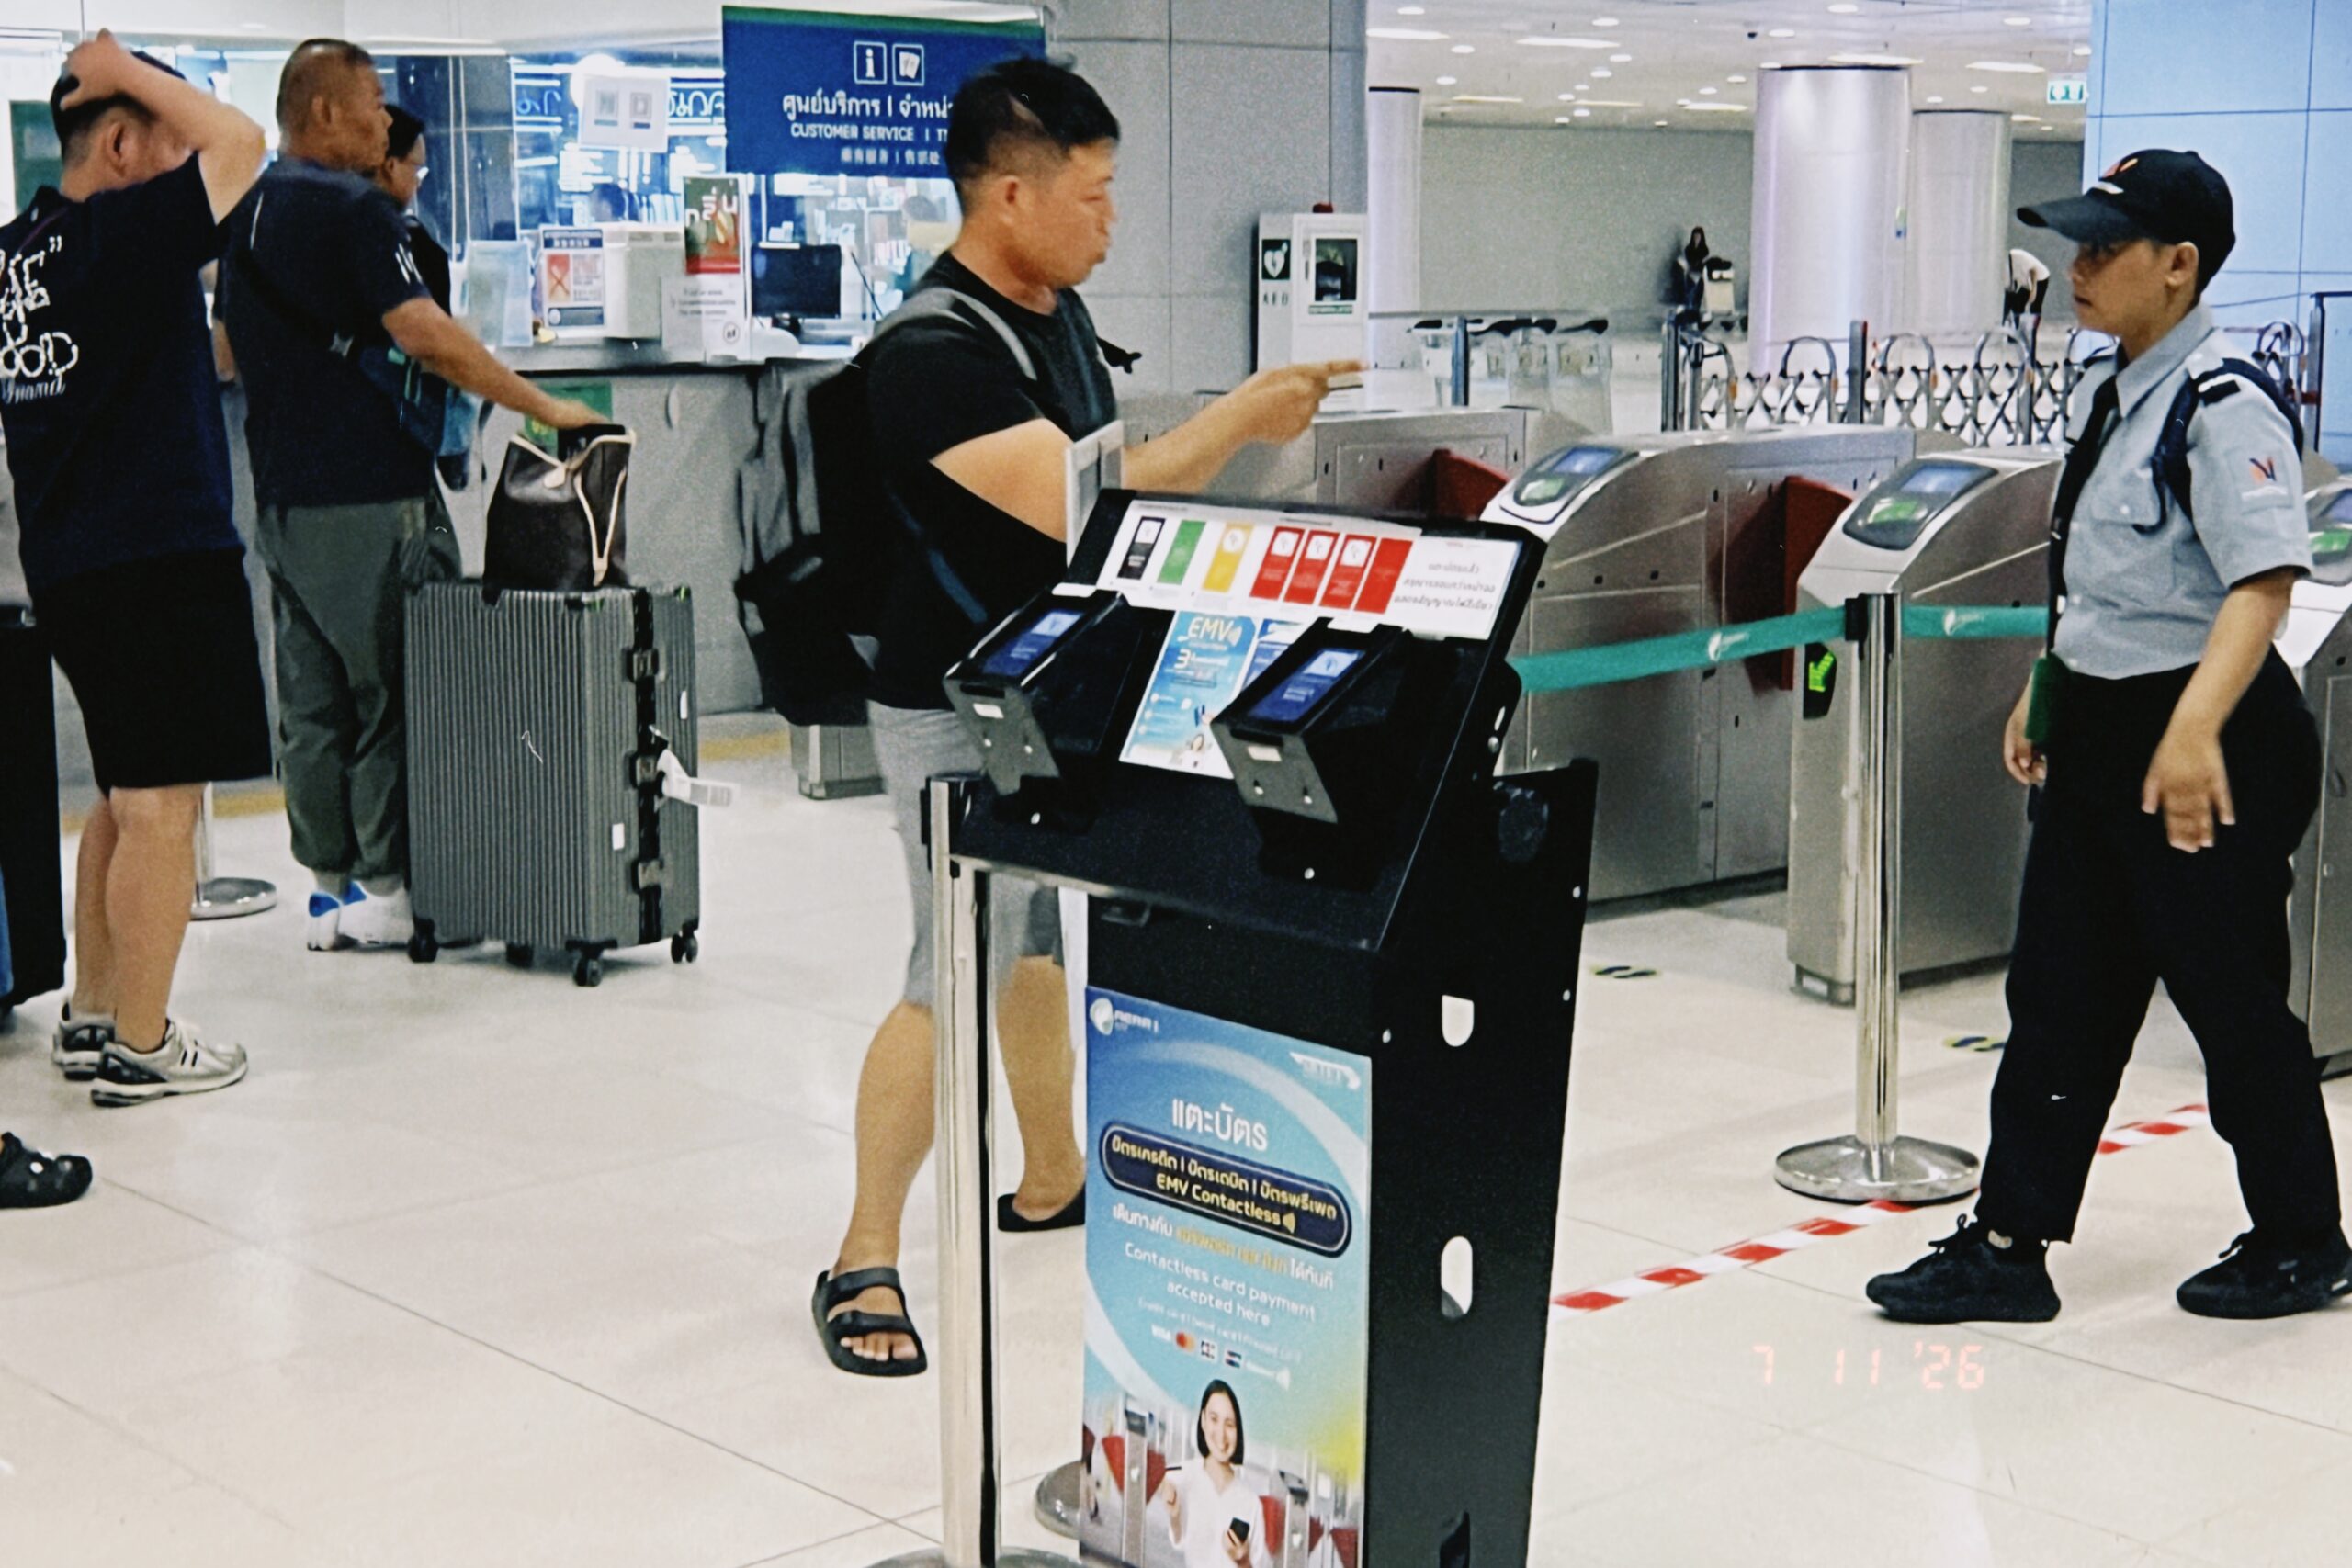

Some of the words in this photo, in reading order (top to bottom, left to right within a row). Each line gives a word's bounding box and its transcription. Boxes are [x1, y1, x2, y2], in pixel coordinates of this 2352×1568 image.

[783, 87, 881, 120] ศูนย์บริการ
[899, 93, 953, 119] จำหน่
[790, 122, 858, 139] CUSTOMER
[863, 125, 914, 141] SERVICE
[1188, 616, 1235, 641] EMV
[1171, 1098, 1268, 1152] แตะบัตร
[1111, 1134, 1178, 1170] บัตรเครดิต
[1156, 1173, 1190, 1198] EMV
[1192, 1186, 1281, 1226] Contactless
[1125, 1241, 1209, 1283] Contactless
[1212, 1272, 1247, 1296] card
[1250, 1286, 1317, 1322] payment
[1167, 1280, 1233, 1314] accepted
[1237, 1303, 1271, 1328] here
